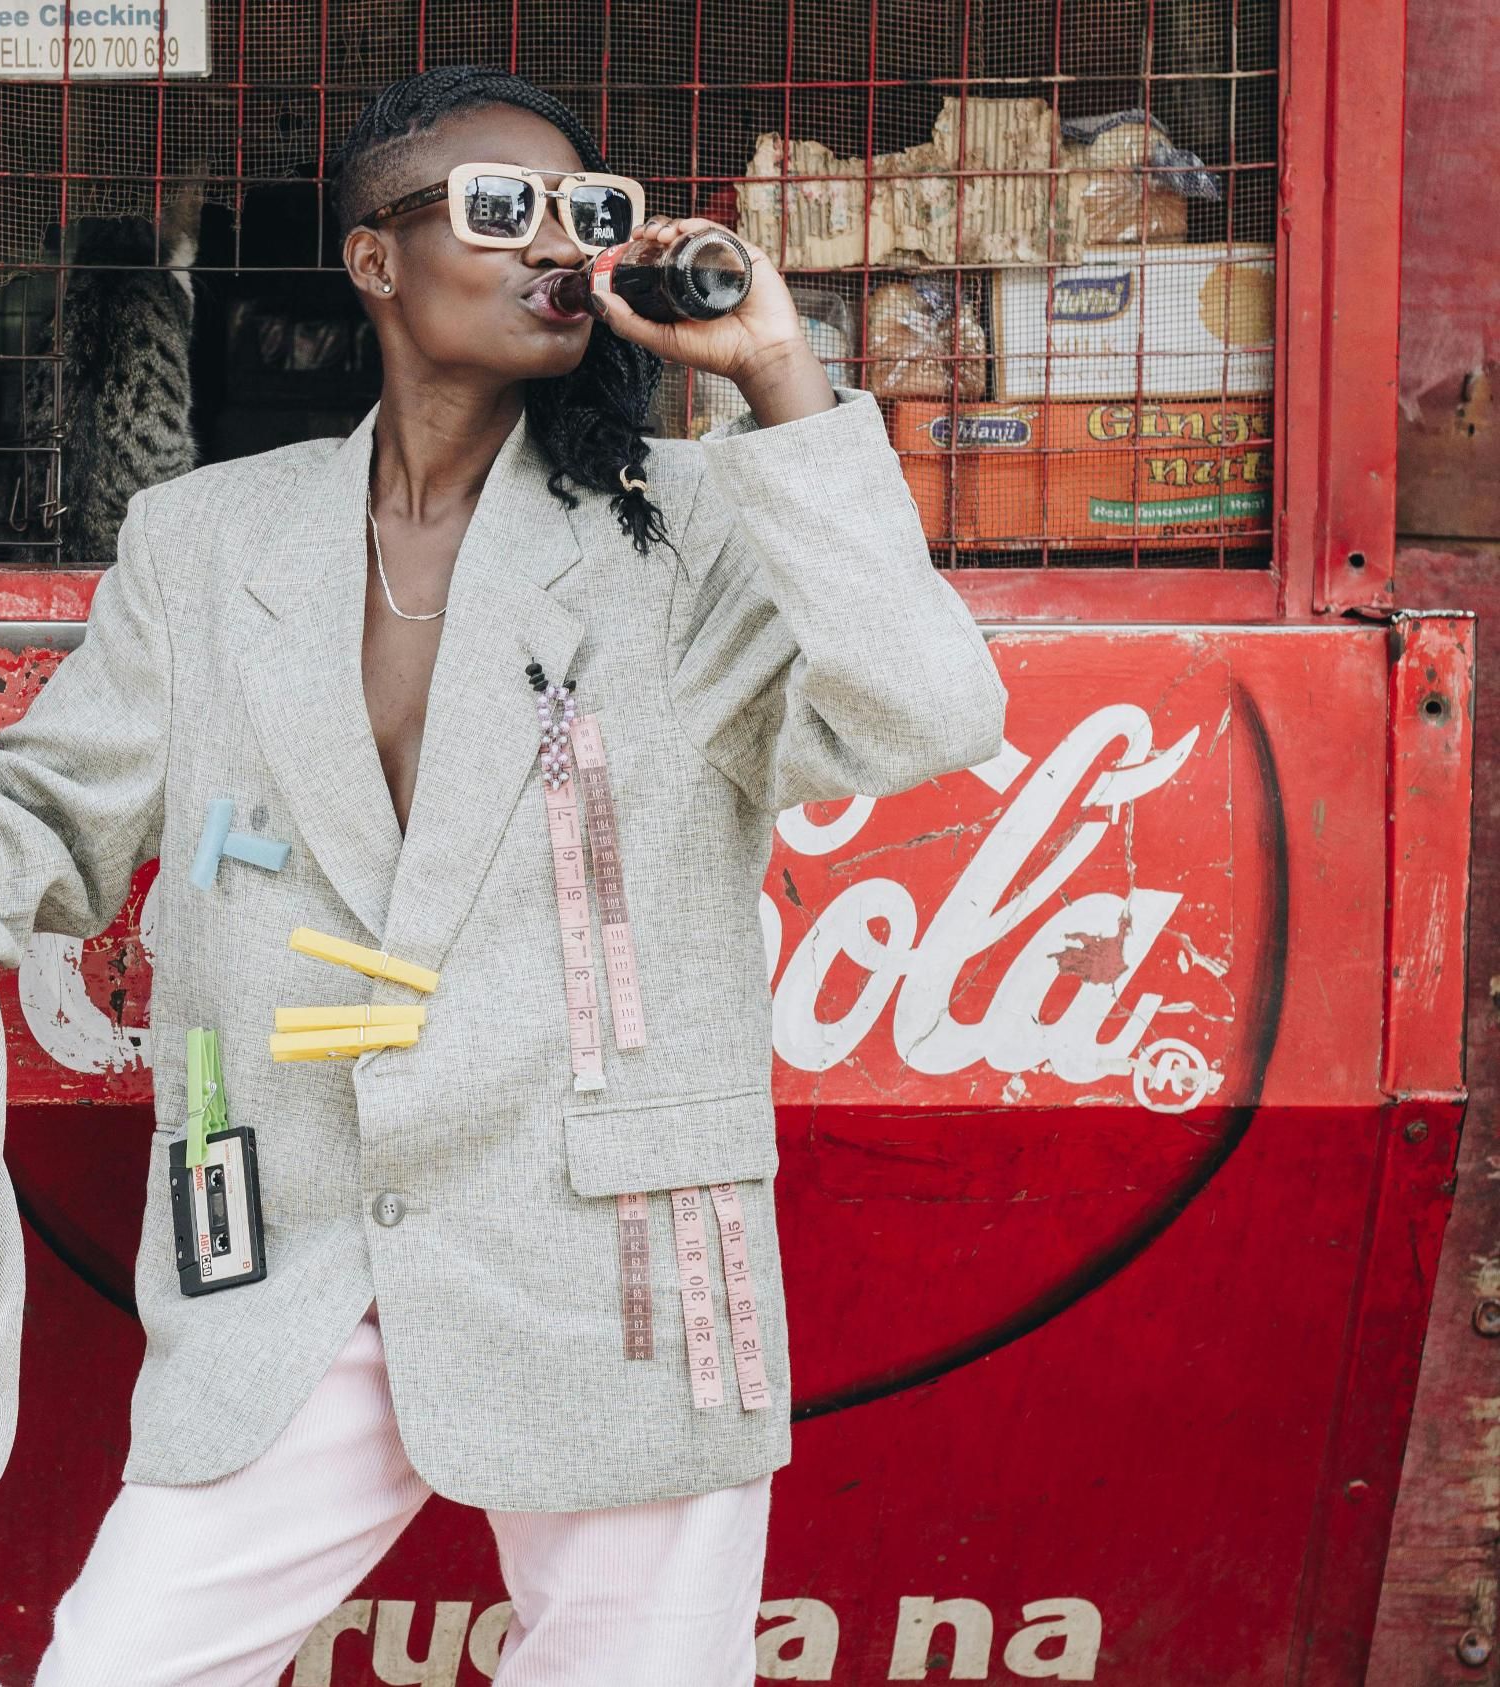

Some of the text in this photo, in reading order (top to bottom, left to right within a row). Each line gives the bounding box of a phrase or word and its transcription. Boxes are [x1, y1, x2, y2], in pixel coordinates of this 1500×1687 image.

[39, 4, 169, 31] Checking
[103, 37, 138, 67] 700
[593, 227, 615, 239] PRADA
[591, 788, 605, 798] 102
[558, 810, 572, 821] 7
[596, 820, 609, 830] 104
[562, 850, 578, 861] 6
[603, 866, 615, 876] 107
[567, 890, 582, 901] 5
[571, 929, 586, 941] 4
[613, 946, 626, 955] 112
[574, 970, 590, 980] 3
[578, 1009, 593, 1020] 2
[200, 1234, 212, 1276] ABC C60
[242, 1261, 250, 1270] B
[632, 1273, 641, 1282] 64
[634, 1320, 643, 1329] 67
[887, 1595, 1102, 1681] na
